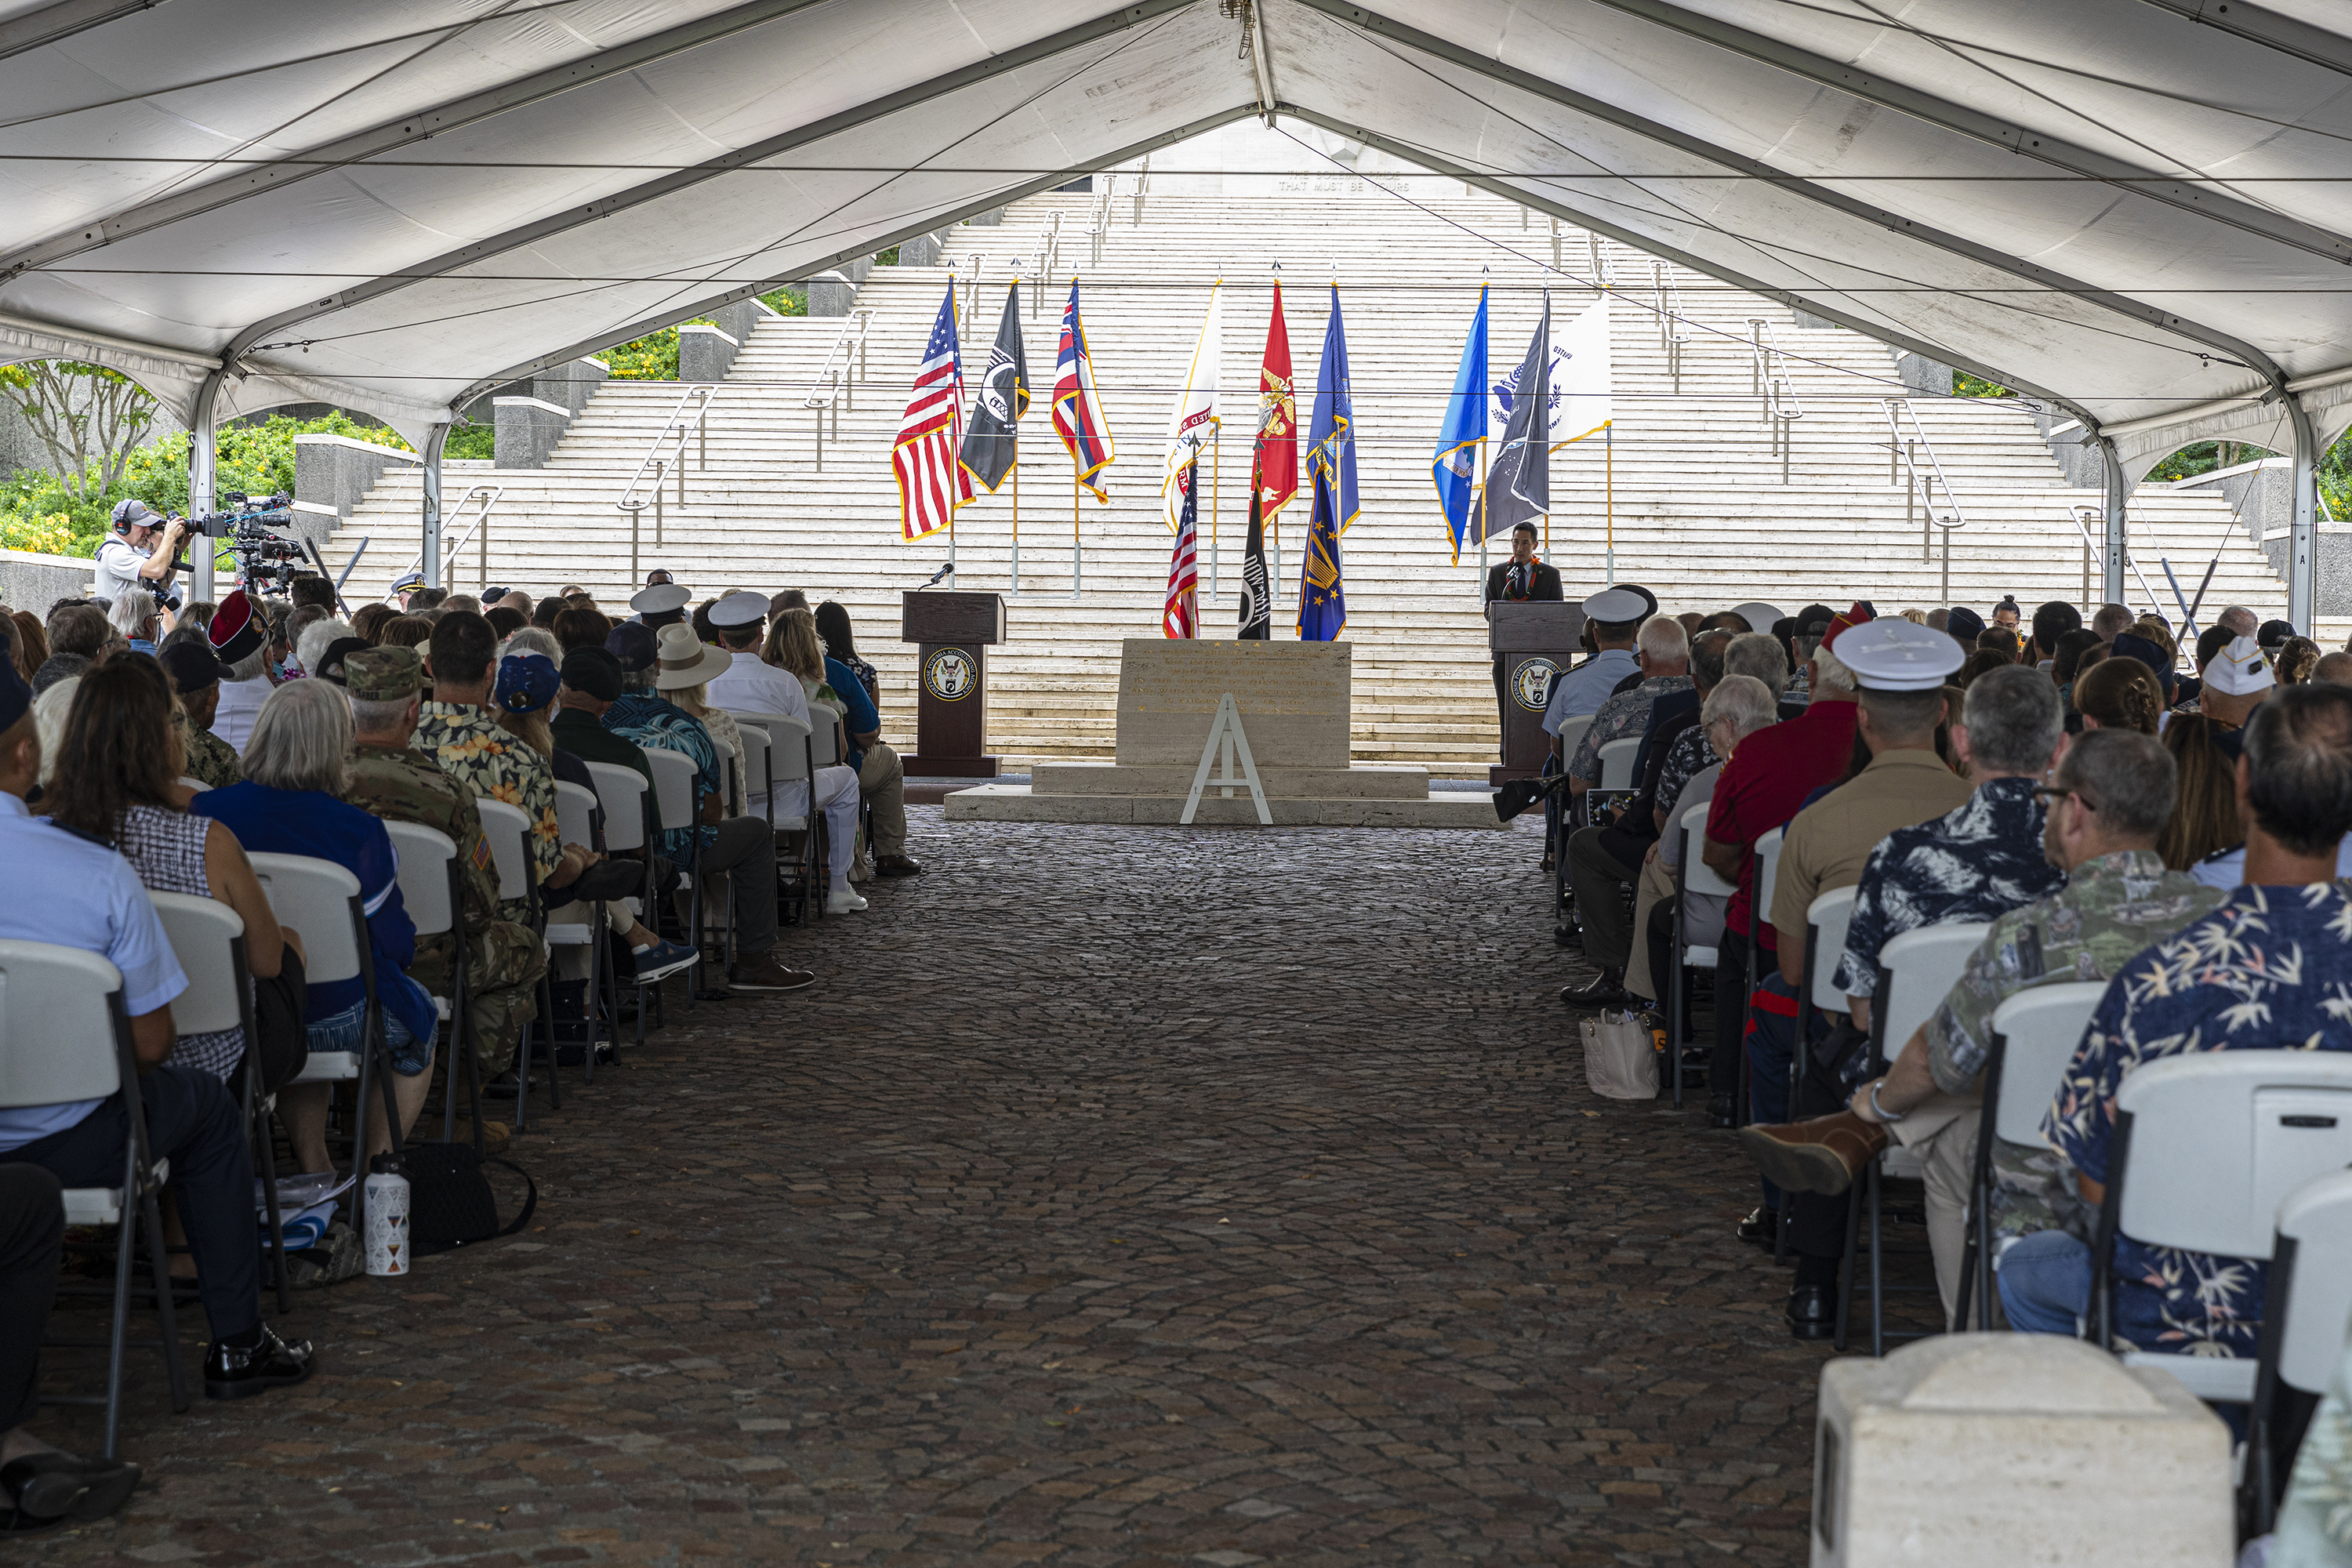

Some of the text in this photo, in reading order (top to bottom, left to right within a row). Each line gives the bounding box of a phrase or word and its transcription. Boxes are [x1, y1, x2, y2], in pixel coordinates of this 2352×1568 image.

[1279, 182, 1410, 192] THAT MUST BE YOURS
[2112, 557, 2117, 566] A
[2299, 554, 2305, 564] A
[927, 650, 975, 695] DEFENSE POW/MIA ACCOUNTING AGENCY
[1513, 660, 1560, 705] DEFENSE POW/MIA ACCOUNT
